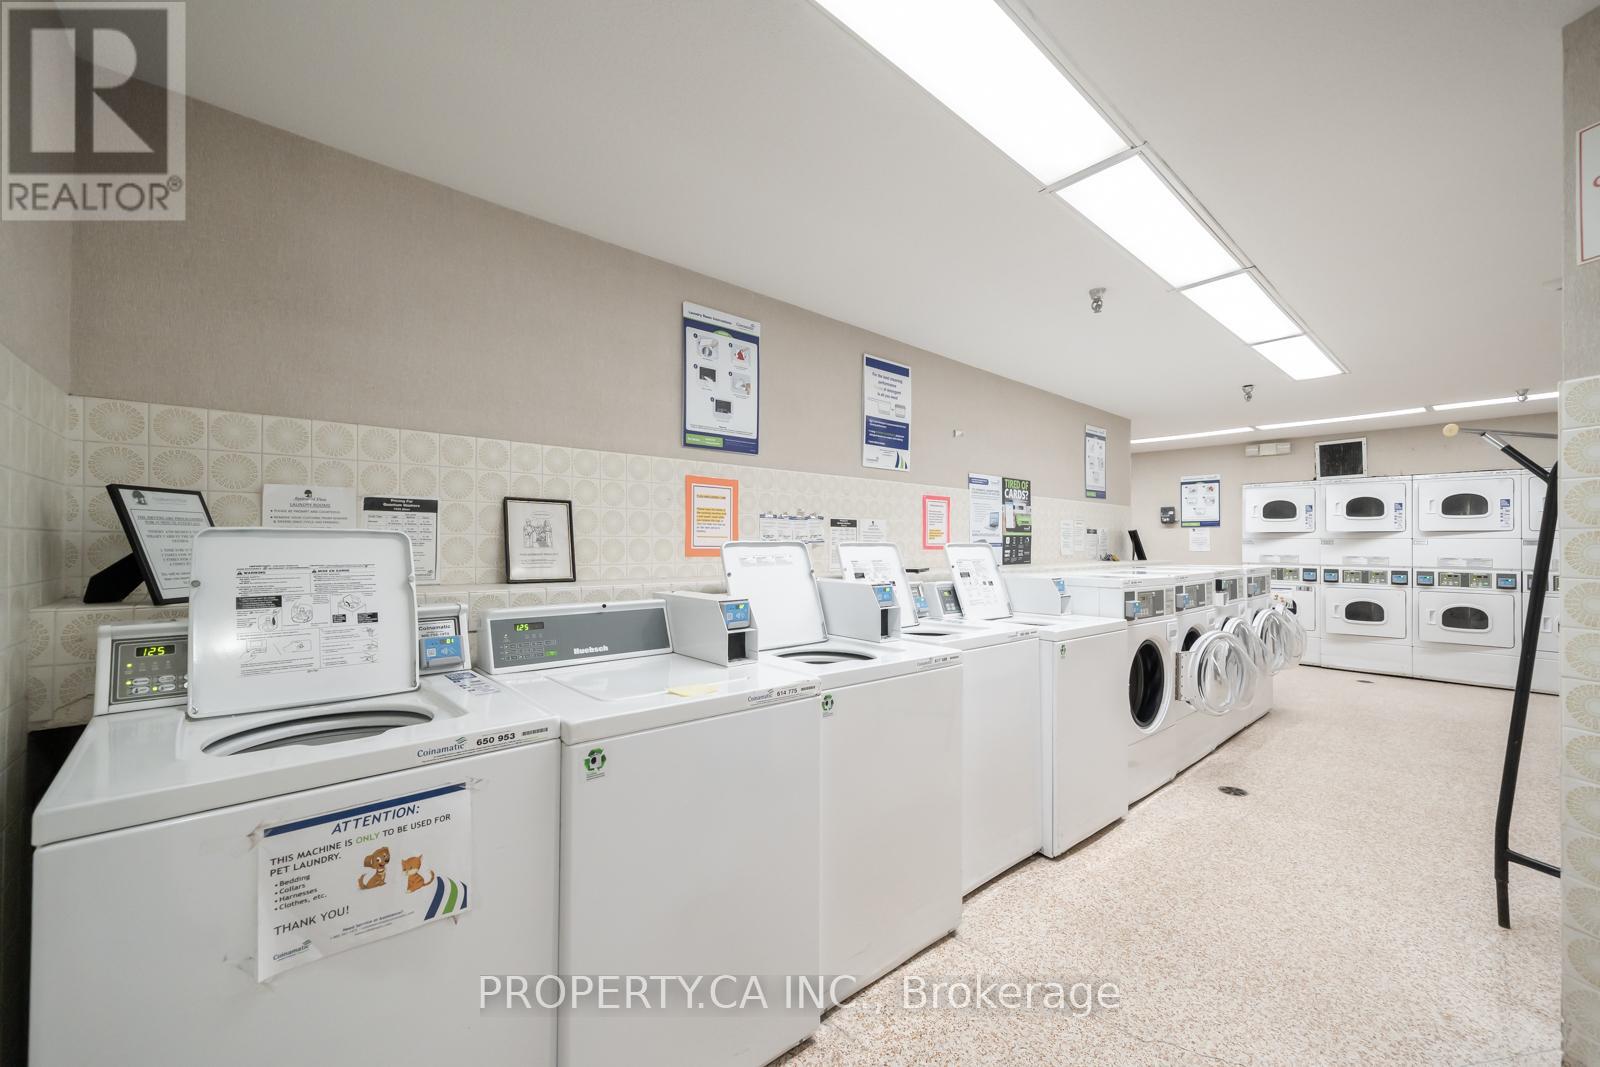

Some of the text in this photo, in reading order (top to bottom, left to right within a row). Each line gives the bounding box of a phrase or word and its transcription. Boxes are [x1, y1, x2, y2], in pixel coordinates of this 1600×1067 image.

[1005, 479, 1030, 491] TIRED OF
[1004, 488, 1029, 501] CARDS?
[573, 644, 609, 655] Huebsch
[417, 743, 465, 758] Coinamatic
[476, 737, 495, 746] 650
[497, 732, 516, 742] 953
[331, 805, 420, 835] ATTENTION:
[270, 813, 452, 866] THIS MACHINE IS ONLY TO BE USED FOR
[269, 852, 342, 877] PET LAUNDRY.
[279, 874, 311, 887] Bedding
[279, 883, 306, 894] Collars
[279, 888, 318, 902] Harnesses
[279, 893, 328, 910] Clothes, etc.
[273, 915, 317, 935] THANK
[321, 905, 350, 921] YOU!
